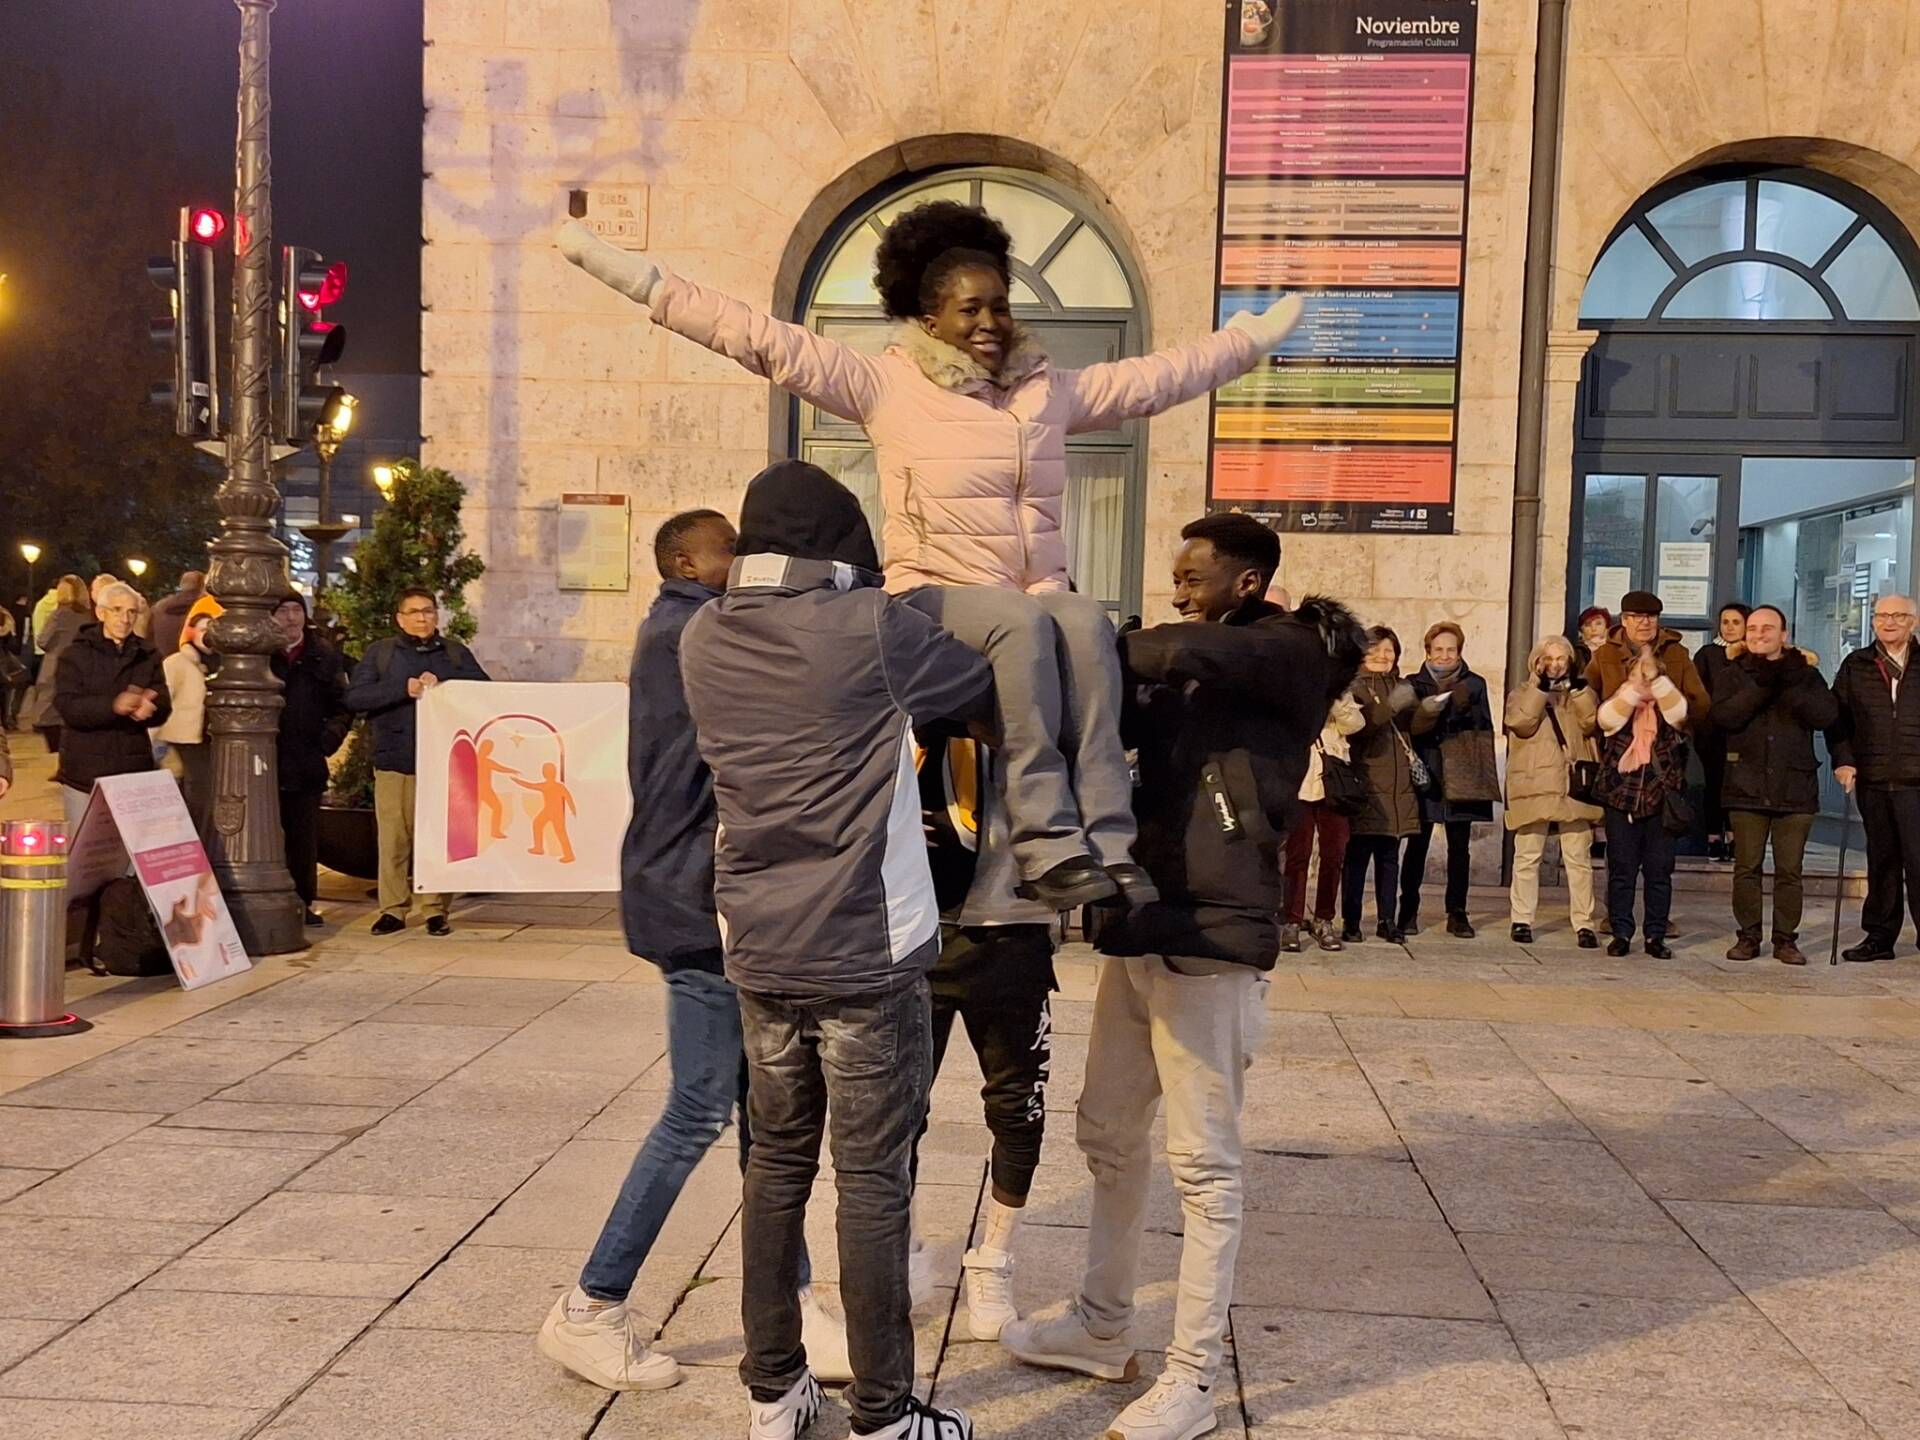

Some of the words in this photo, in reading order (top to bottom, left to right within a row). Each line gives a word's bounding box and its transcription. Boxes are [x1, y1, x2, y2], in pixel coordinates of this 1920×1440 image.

[1355, 16, 1460, 35] Noviembre
[1367, 37, 1424, 49] Programación
[1424, 37, 1459, 48] Cultural
